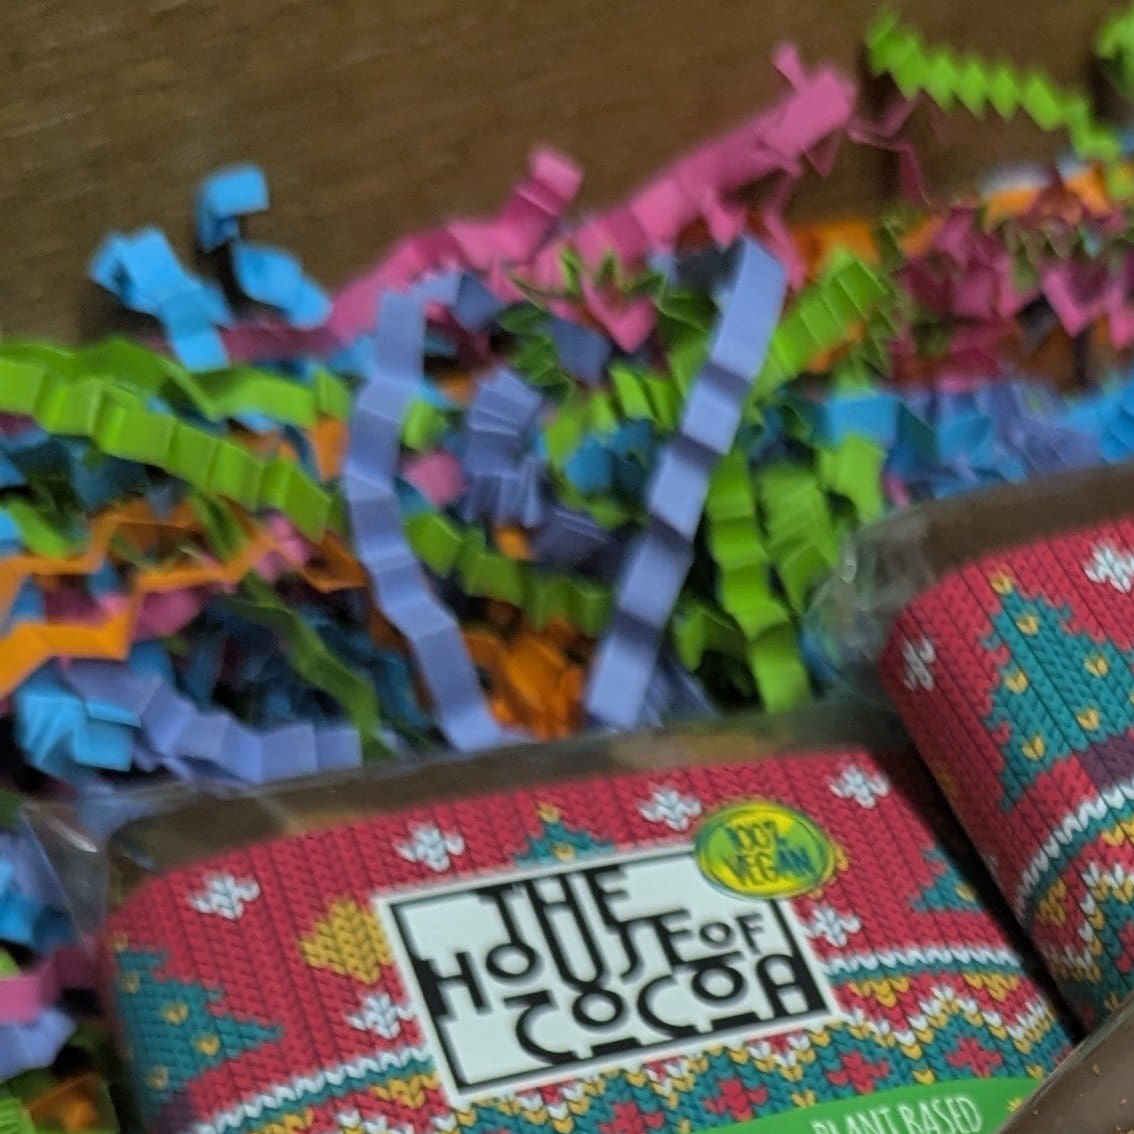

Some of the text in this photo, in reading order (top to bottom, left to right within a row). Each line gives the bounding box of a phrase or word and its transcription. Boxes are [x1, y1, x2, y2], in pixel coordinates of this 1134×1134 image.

[477, 864, 630, 946] THE
[418, 908, 766, 1016] HOUSE OF
[502, 949, 830, 1067] COCOA
